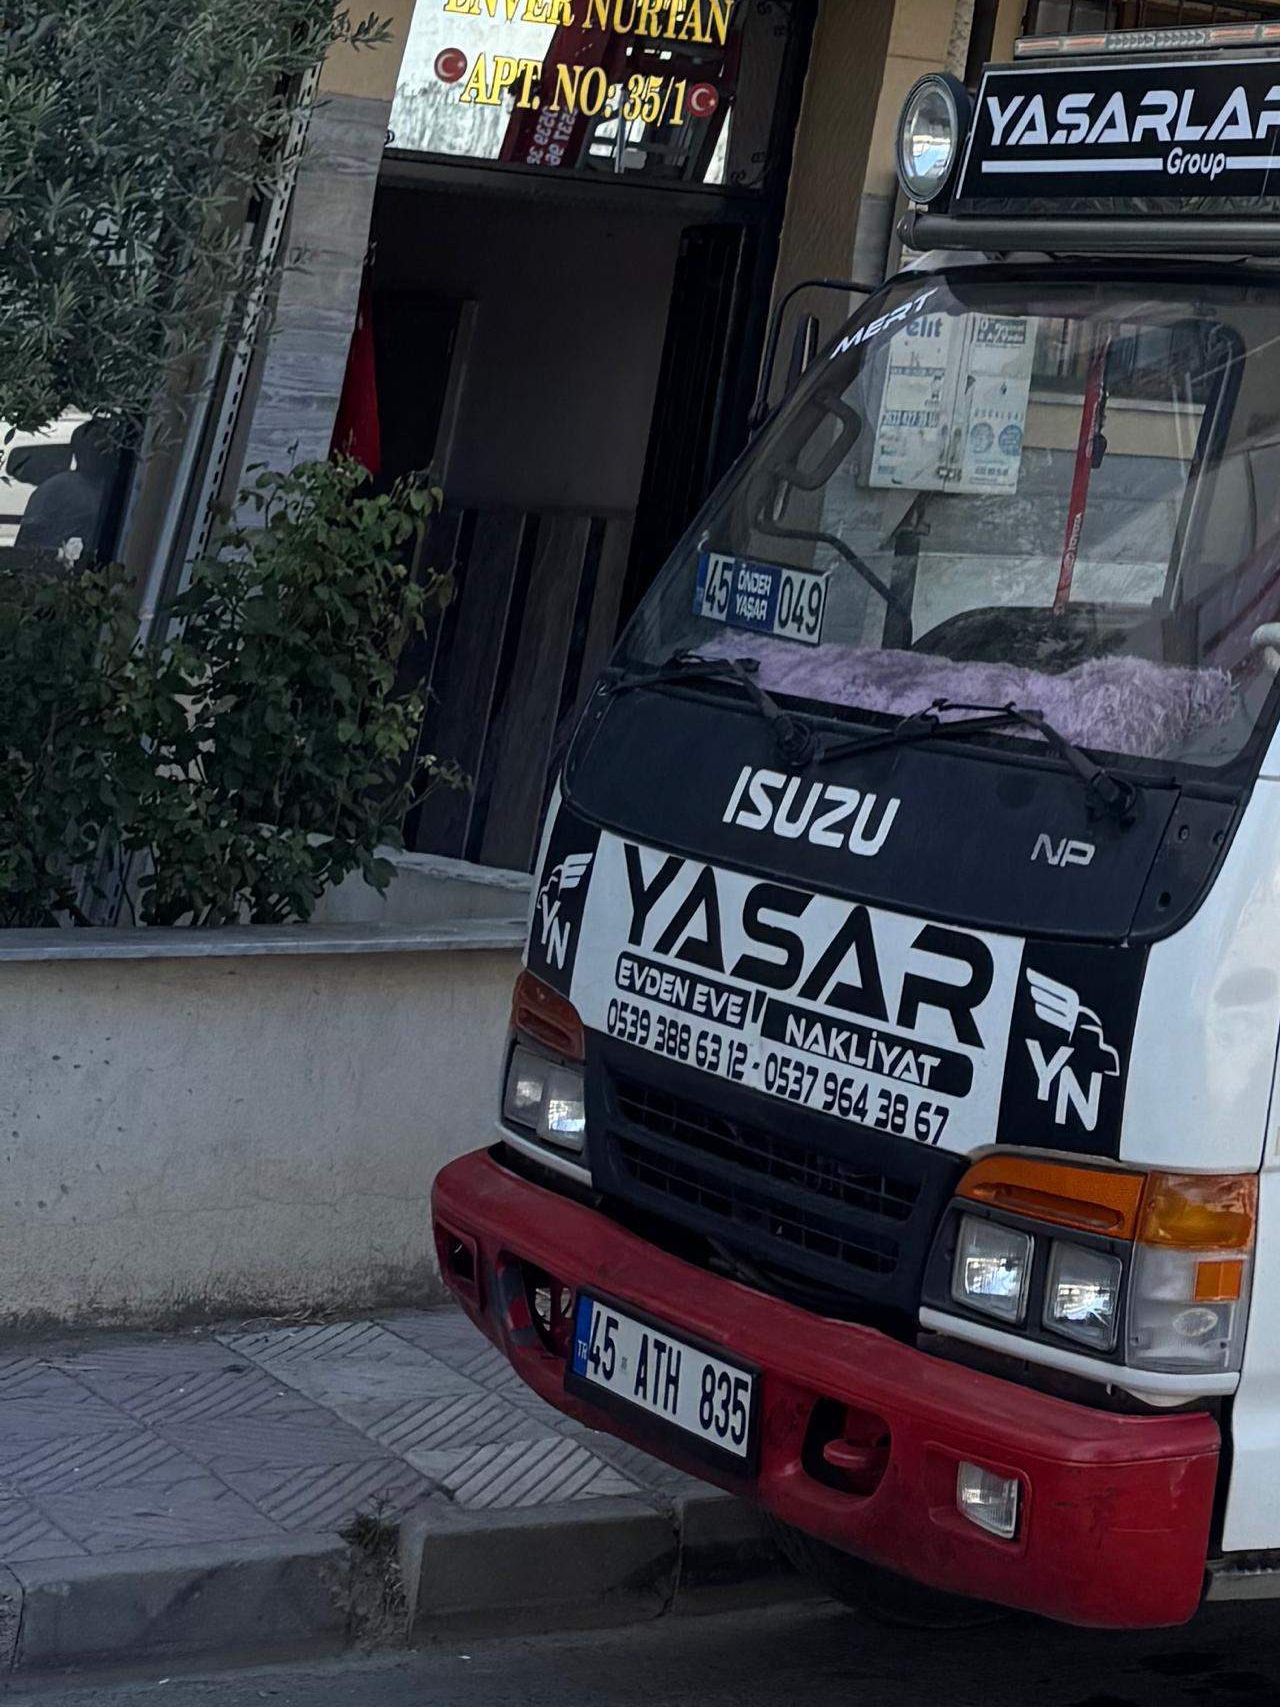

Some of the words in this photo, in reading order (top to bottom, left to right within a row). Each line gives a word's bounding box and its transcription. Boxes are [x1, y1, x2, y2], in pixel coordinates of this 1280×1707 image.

[460, 52, 542, 111] APT.
[550, 64, 616, 118] NO:
[622, 73, 688, 127] 35/1
[1166, 146, 1227, 181] Group
[829, 288, 938, 360] MERT
[705, 560, 733, 614] 45
[778, 575, 823, 635] 049
[722, 766, 901, 857] ISUZU
[1031, 833, 1096, 868] NP
[541, 894, 571, 970] YN
[618, 957, 690, 1008] EVDEN
[691, 983, 745, 1024] EVE
[607, 997, 651, 1047] 0539
[655, 1016, 692, 1061] 388
[695, 1030, 721, 1071] 63
[727, 1038, 748, 1081] 12
[764, 1051, 820, 1104] 0537
[822, 1072, 870, 1123] 964
[873, 1089, 910, 1134] 38
[913, 1101, 950, 1145] 67
[784, 1011, 942, 1087] NAKLİYAT
[1025, 1038, 1103, 1132] YN
[577, 1340, 588, 1359] TR
[589, 1310, 619, 1381] 45
[633, 1333, 682, 1415] ATH
[699, 1363, 749, 1445] 835
